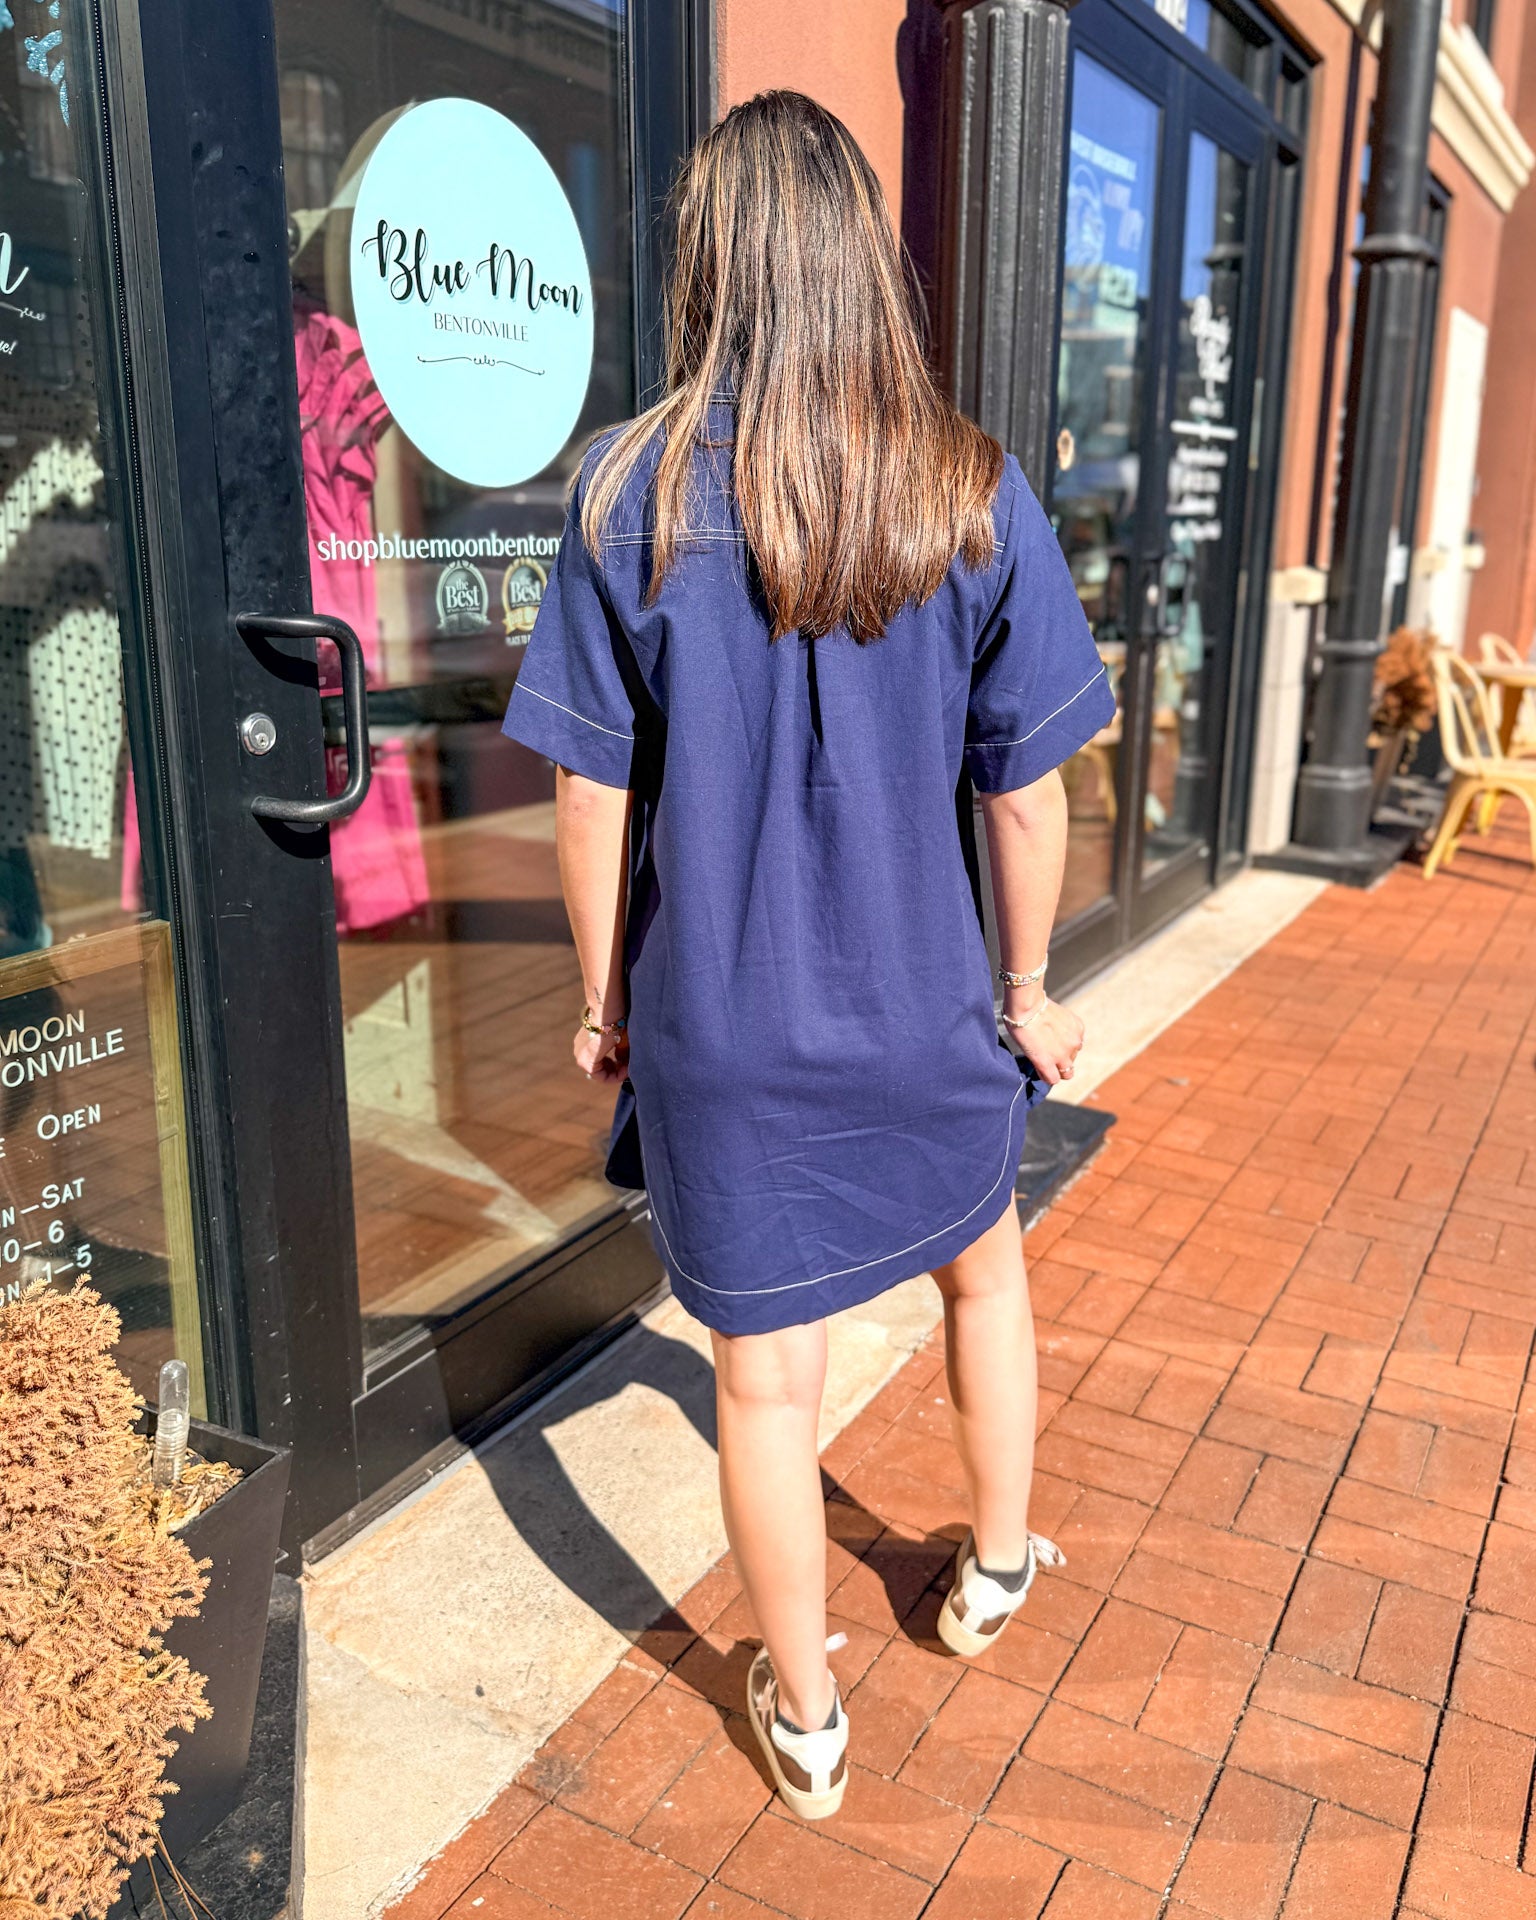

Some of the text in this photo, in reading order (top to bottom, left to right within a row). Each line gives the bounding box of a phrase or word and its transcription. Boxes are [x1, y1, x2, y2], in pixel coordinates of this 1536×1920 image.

[362, 219, 583, 315] Blue Moon
[434, 312, 529, 342] BENTONVILLE
[317, 532, 562, 567] shopbluemoonbenton
[445, 586, 480, 608] Best
[456, 578, 469, 590] the
[510, 581, 542, 603] Best
[0, 1009, 85, 1058] MOON
[1, 1028, 125, 1088] ONVILLE
[37, 1103, 101, 1140] OPEN
